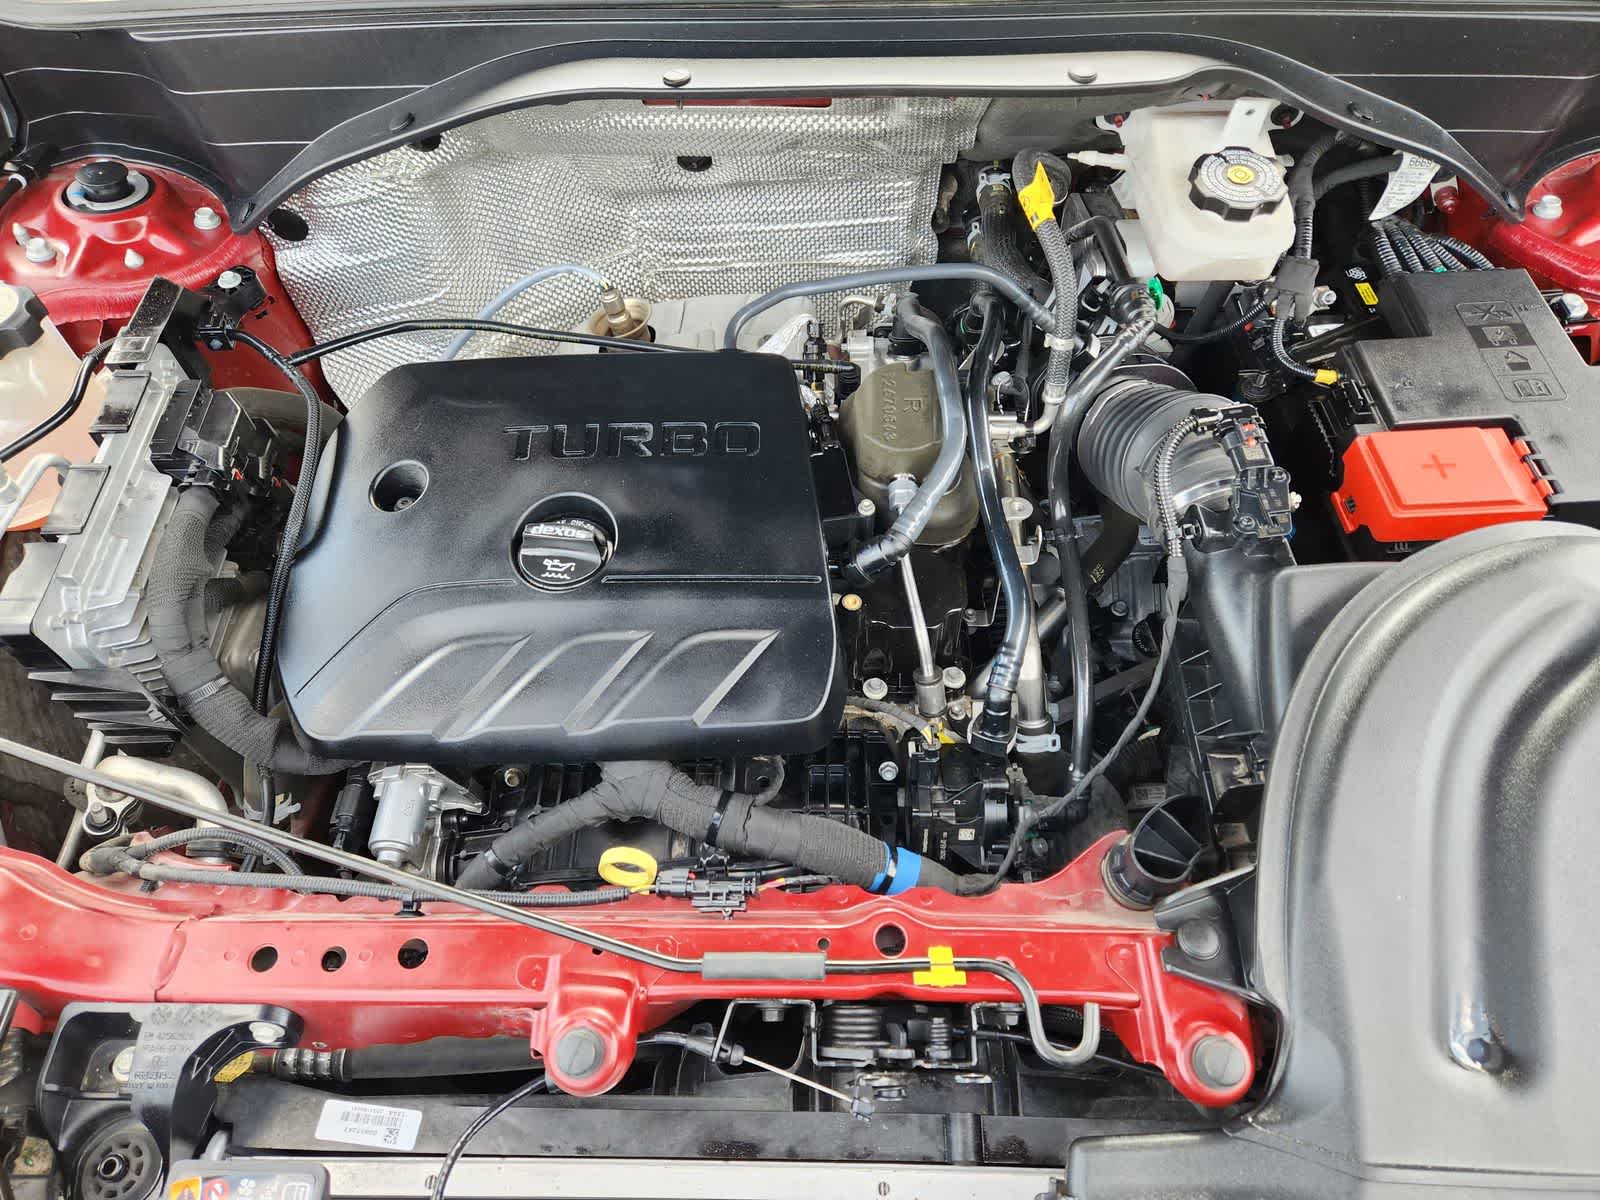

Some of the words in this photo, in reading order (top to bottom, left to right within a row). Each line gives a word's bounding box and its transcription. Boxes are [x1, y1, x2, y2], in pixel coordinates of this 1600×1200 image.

[903, 396, 924, 415] R
[503, 421, 761, 461] TURBO
[531, 523, 588, 539] dexos
